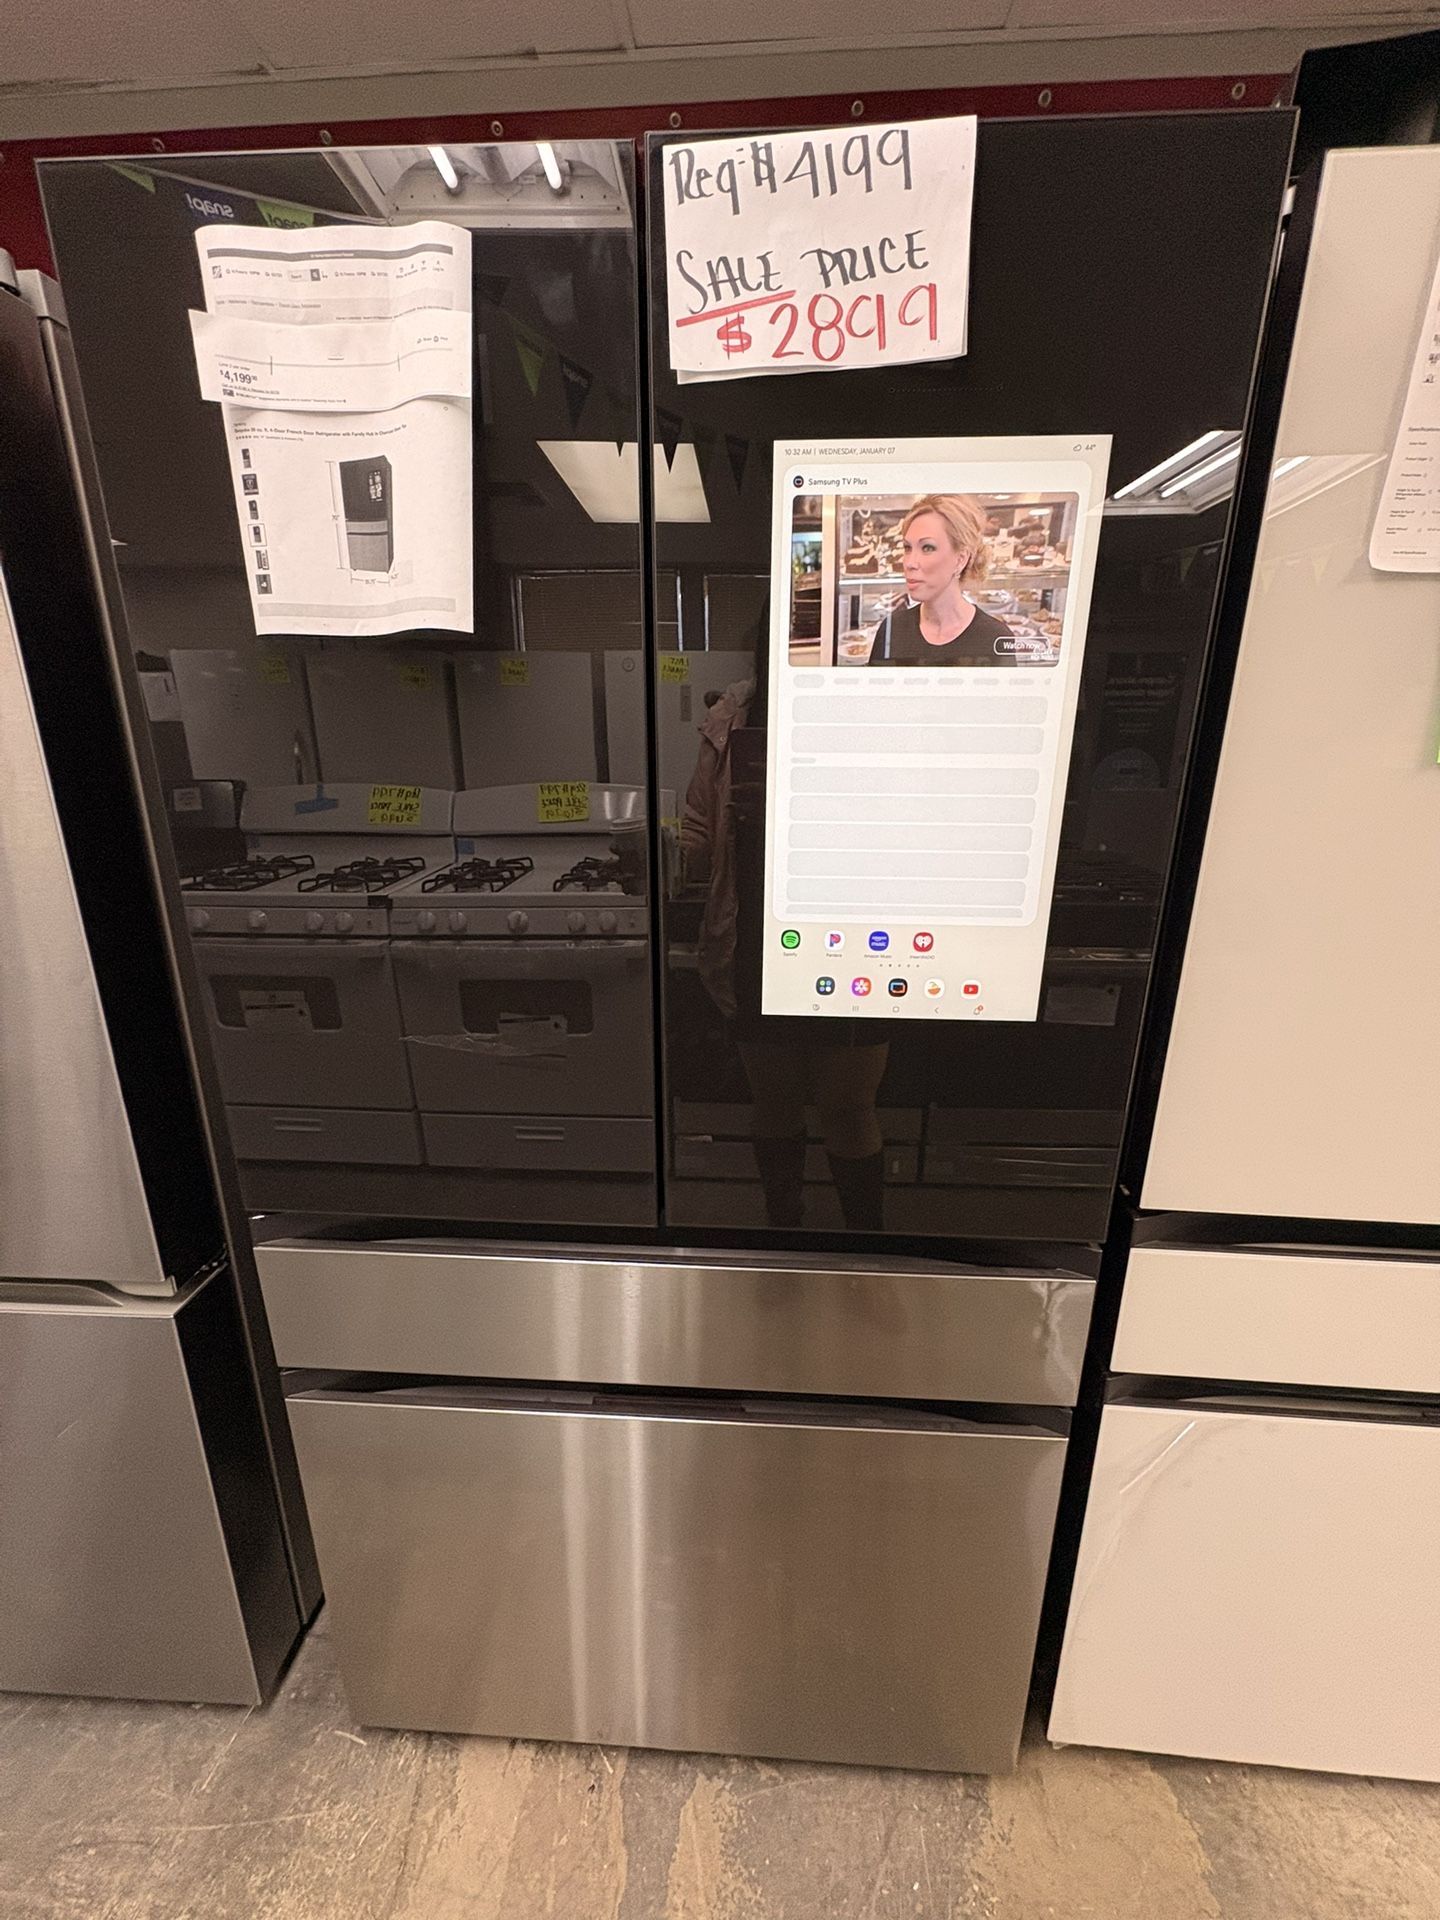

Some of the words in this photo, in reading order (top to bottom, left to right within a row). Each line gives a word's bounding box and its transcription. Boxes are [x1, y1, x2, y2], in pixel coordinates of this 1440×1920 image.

[676, 250, 783, 314] SALE
[800, 230, 929, 289] PRICE
[802, 448, 812, 456] AM
[819, 448, 858, 456] WEDNESDAY,
[859, 447, 886, 455] JANUARY
[887, 447, 896, 455] 07
[808, 478, 840, 487] Samsung
[842, 477, 852, 485] TV
[853, 477, 868, 486] Plus
[1003, 641, 1025, 650] Watch
